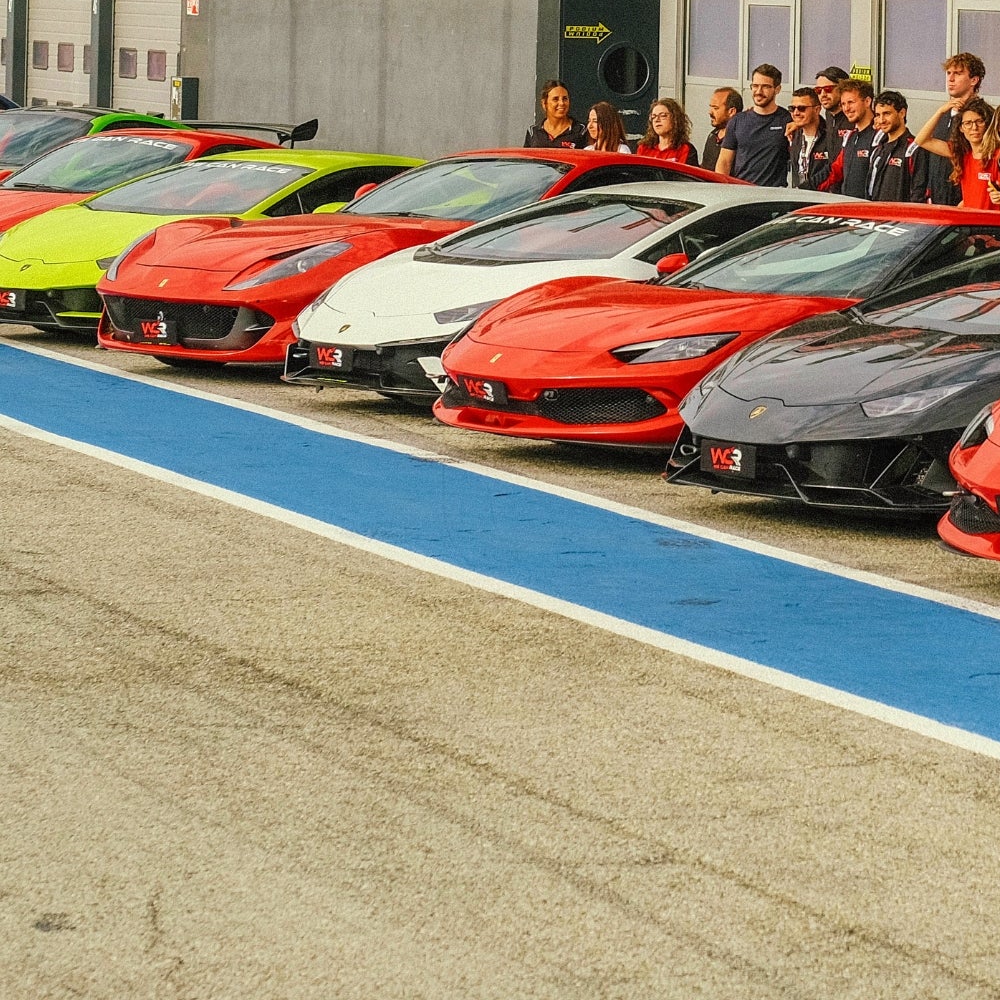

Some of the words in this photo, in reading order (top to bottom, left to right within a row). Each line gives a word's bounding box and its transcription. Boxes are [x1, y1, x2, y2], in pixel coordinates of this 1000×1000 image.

[127, 137, 179, 150] RACE
[241, 163, 293, 174] RACE
[796, 216, 841, 226] CAN
[839, 219, 909, 237] RACE
